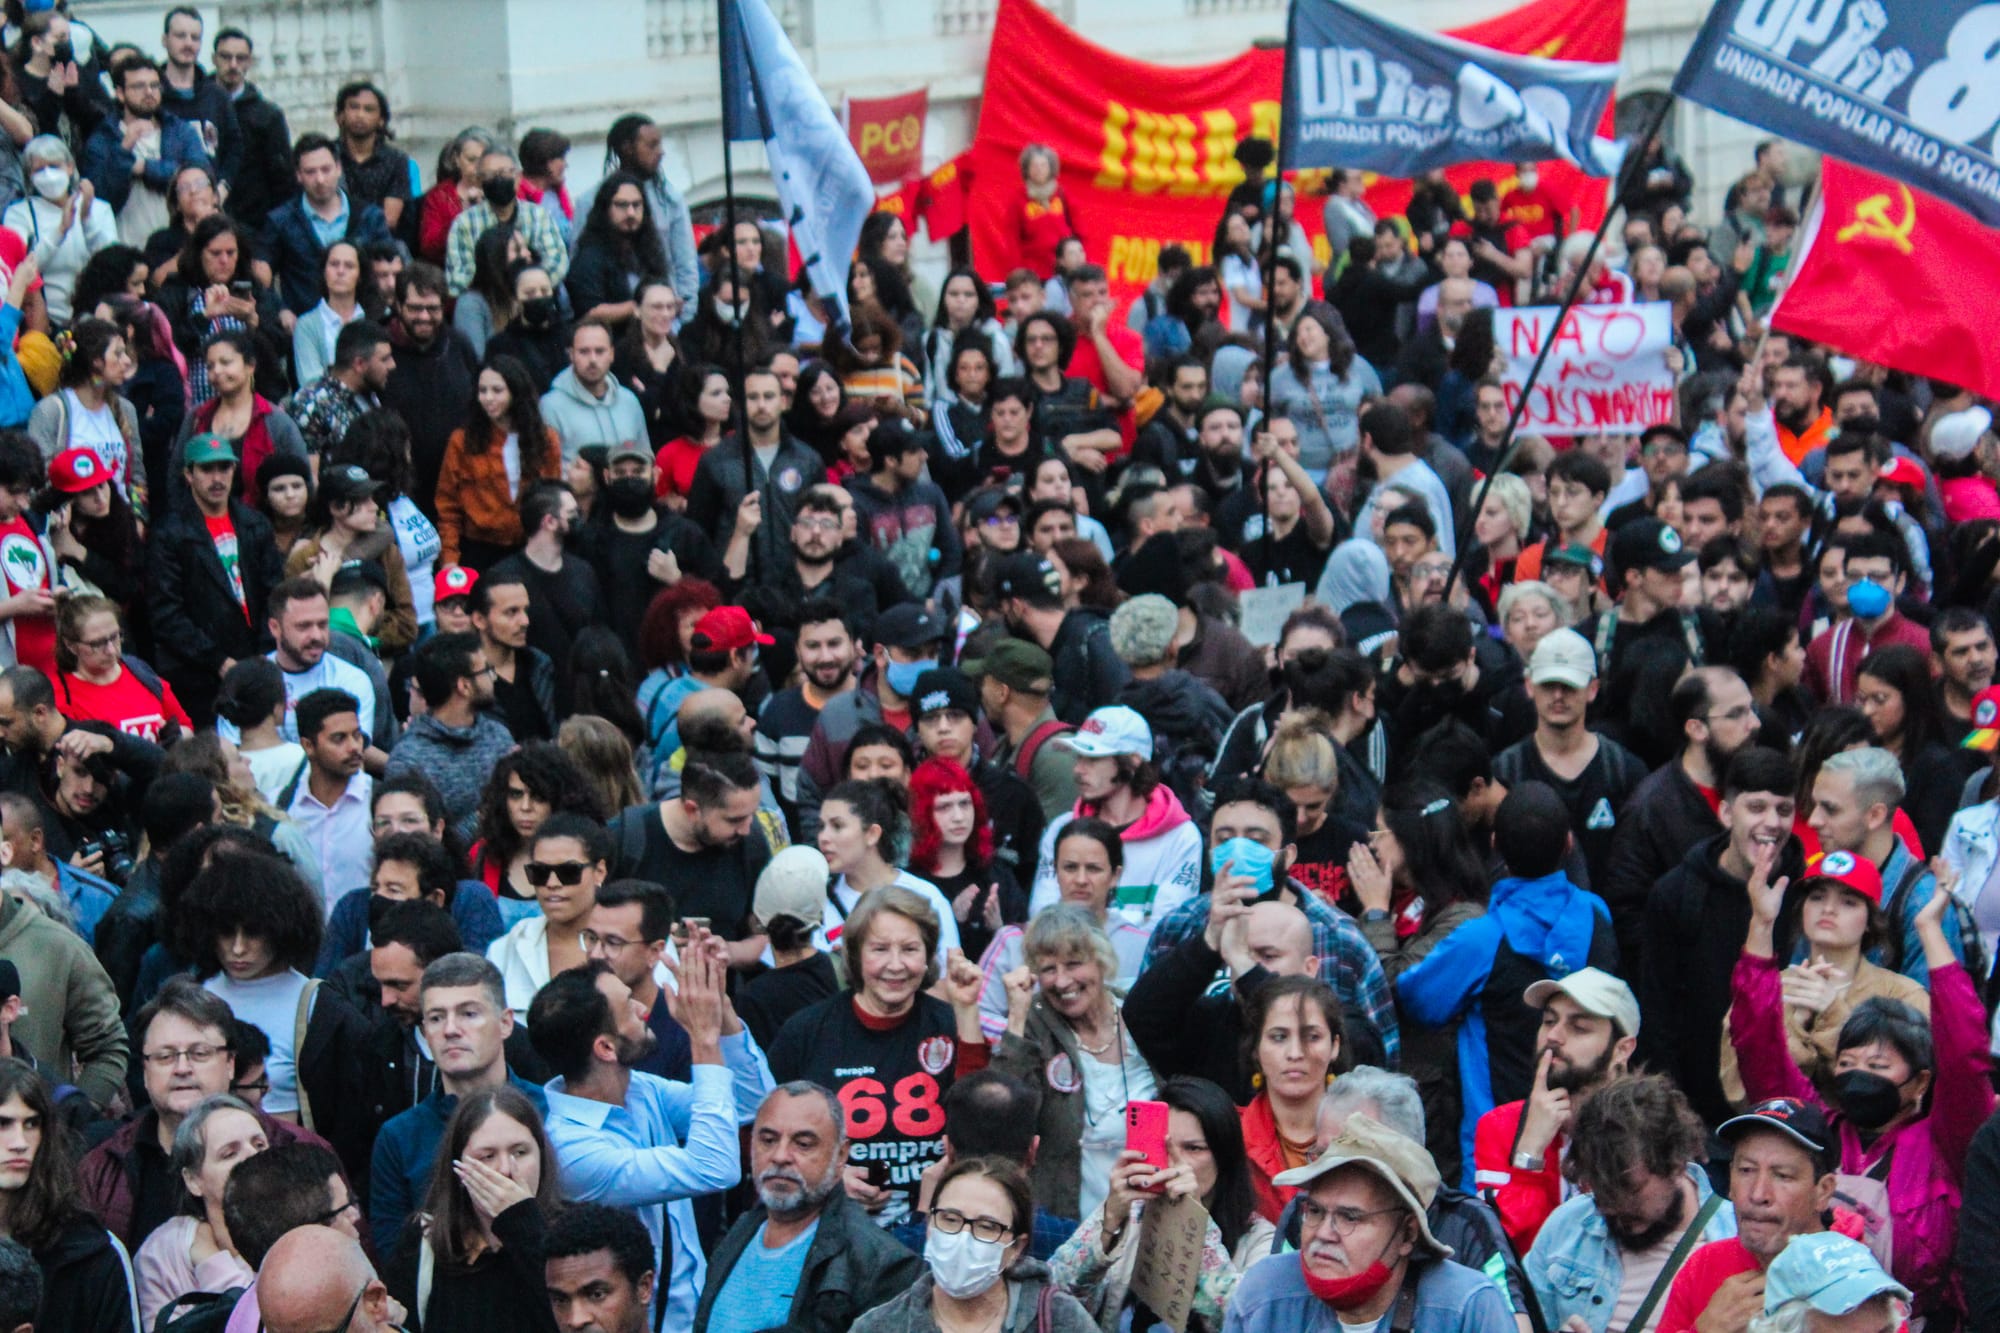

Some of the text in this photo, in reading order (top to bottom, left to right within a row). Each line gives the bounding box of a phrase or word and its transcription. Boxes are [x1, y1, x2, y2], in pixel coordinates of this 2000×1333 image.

[1299, 46, 1377, 119] UP
[1908, 2, 2000, 166] 8
[1300, 121, 1381, 145] UNIDADE
[1714, 44, 2000, 203] UNIDADE POPULAR PELO SOCIA
[1512, 304, 1645, 361] NÃO
[1559, 358, 1614, 383] AO
[834, 1065, 876, 1077] geração
[837, 1071, 947, 1139] 68
[848, 1139, 946, 1163] empre
